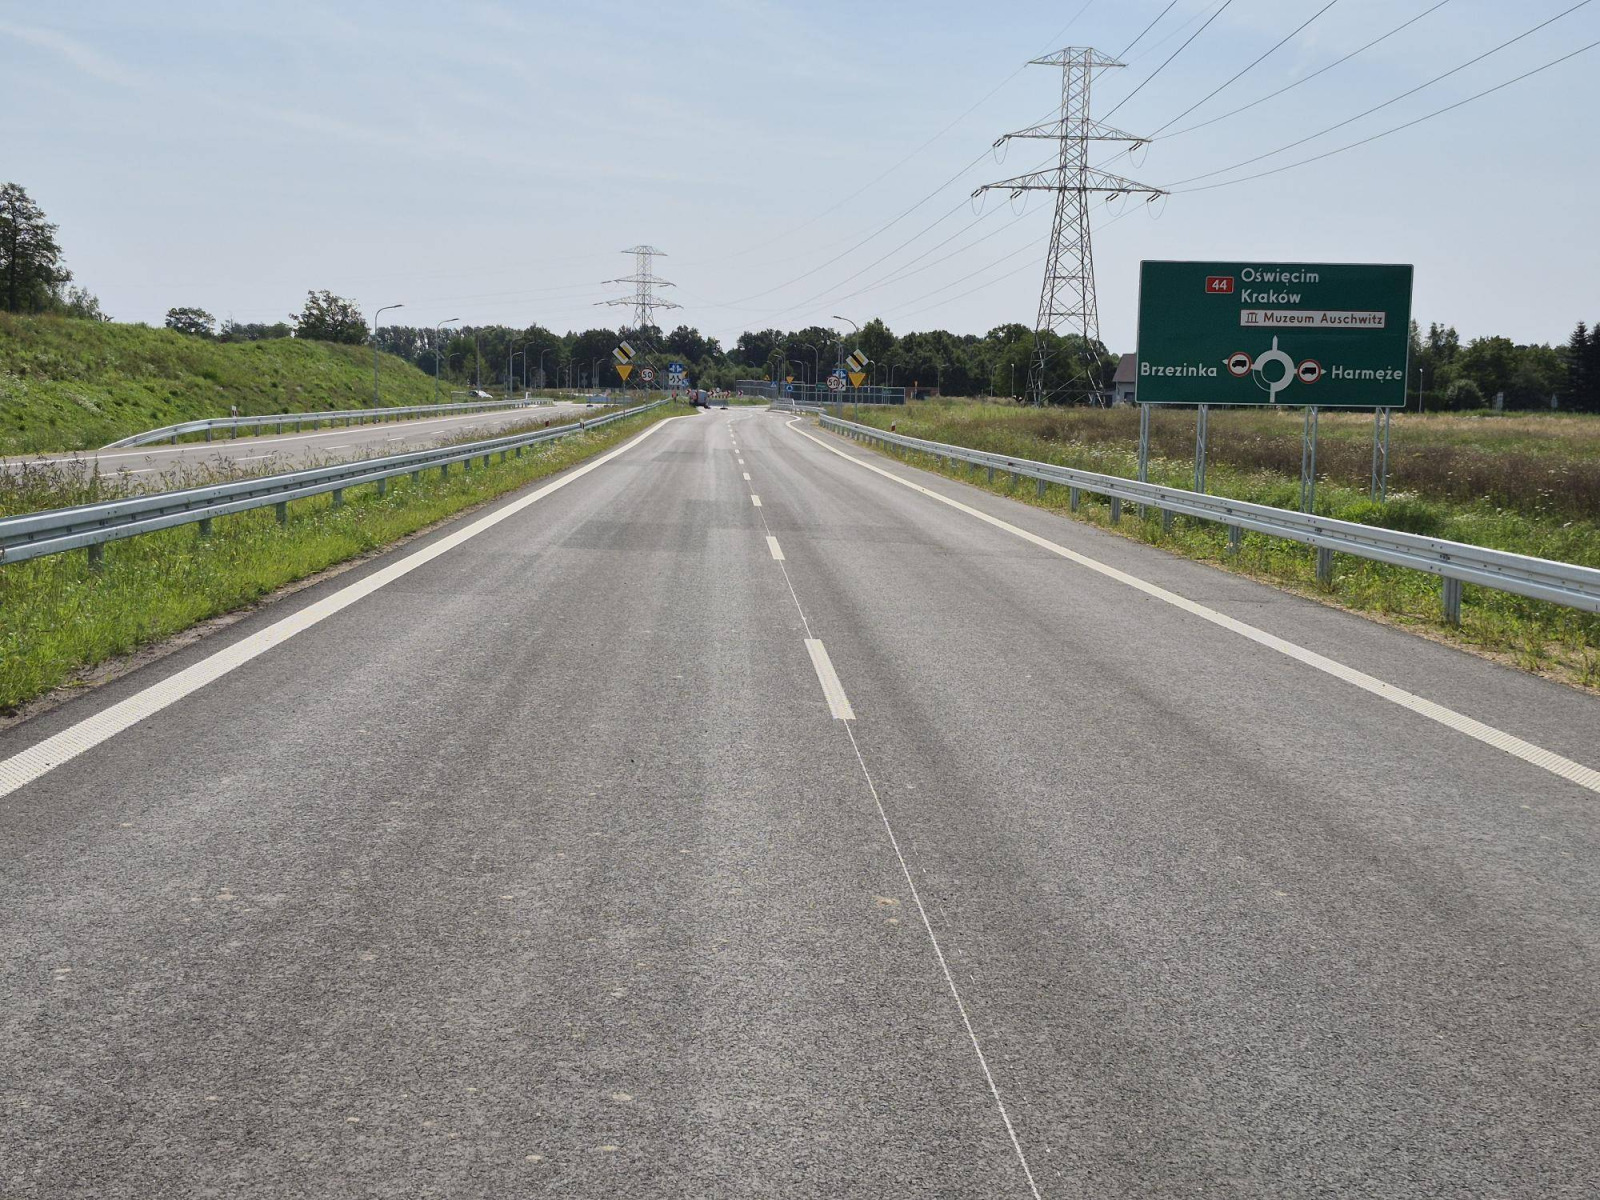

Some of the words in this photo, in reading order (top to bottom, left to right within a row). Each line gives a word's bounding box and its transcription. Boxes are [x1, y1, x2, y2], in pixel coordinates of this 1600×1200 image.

[1241, 267, 1320, 286] Oświęcim
[1211, 279, 1228, 291] 44
[1241, 288, 1302, 304] Kraków
[1263, 312, 1314, 324] Muzeum
[1320, 312, 1383, 325] Auschwitz
[642, 371, 653, 379] 50
[1140, 361, 1217, 377] Brzezinka
[1331, 365, 1403, 384] Harmęże
